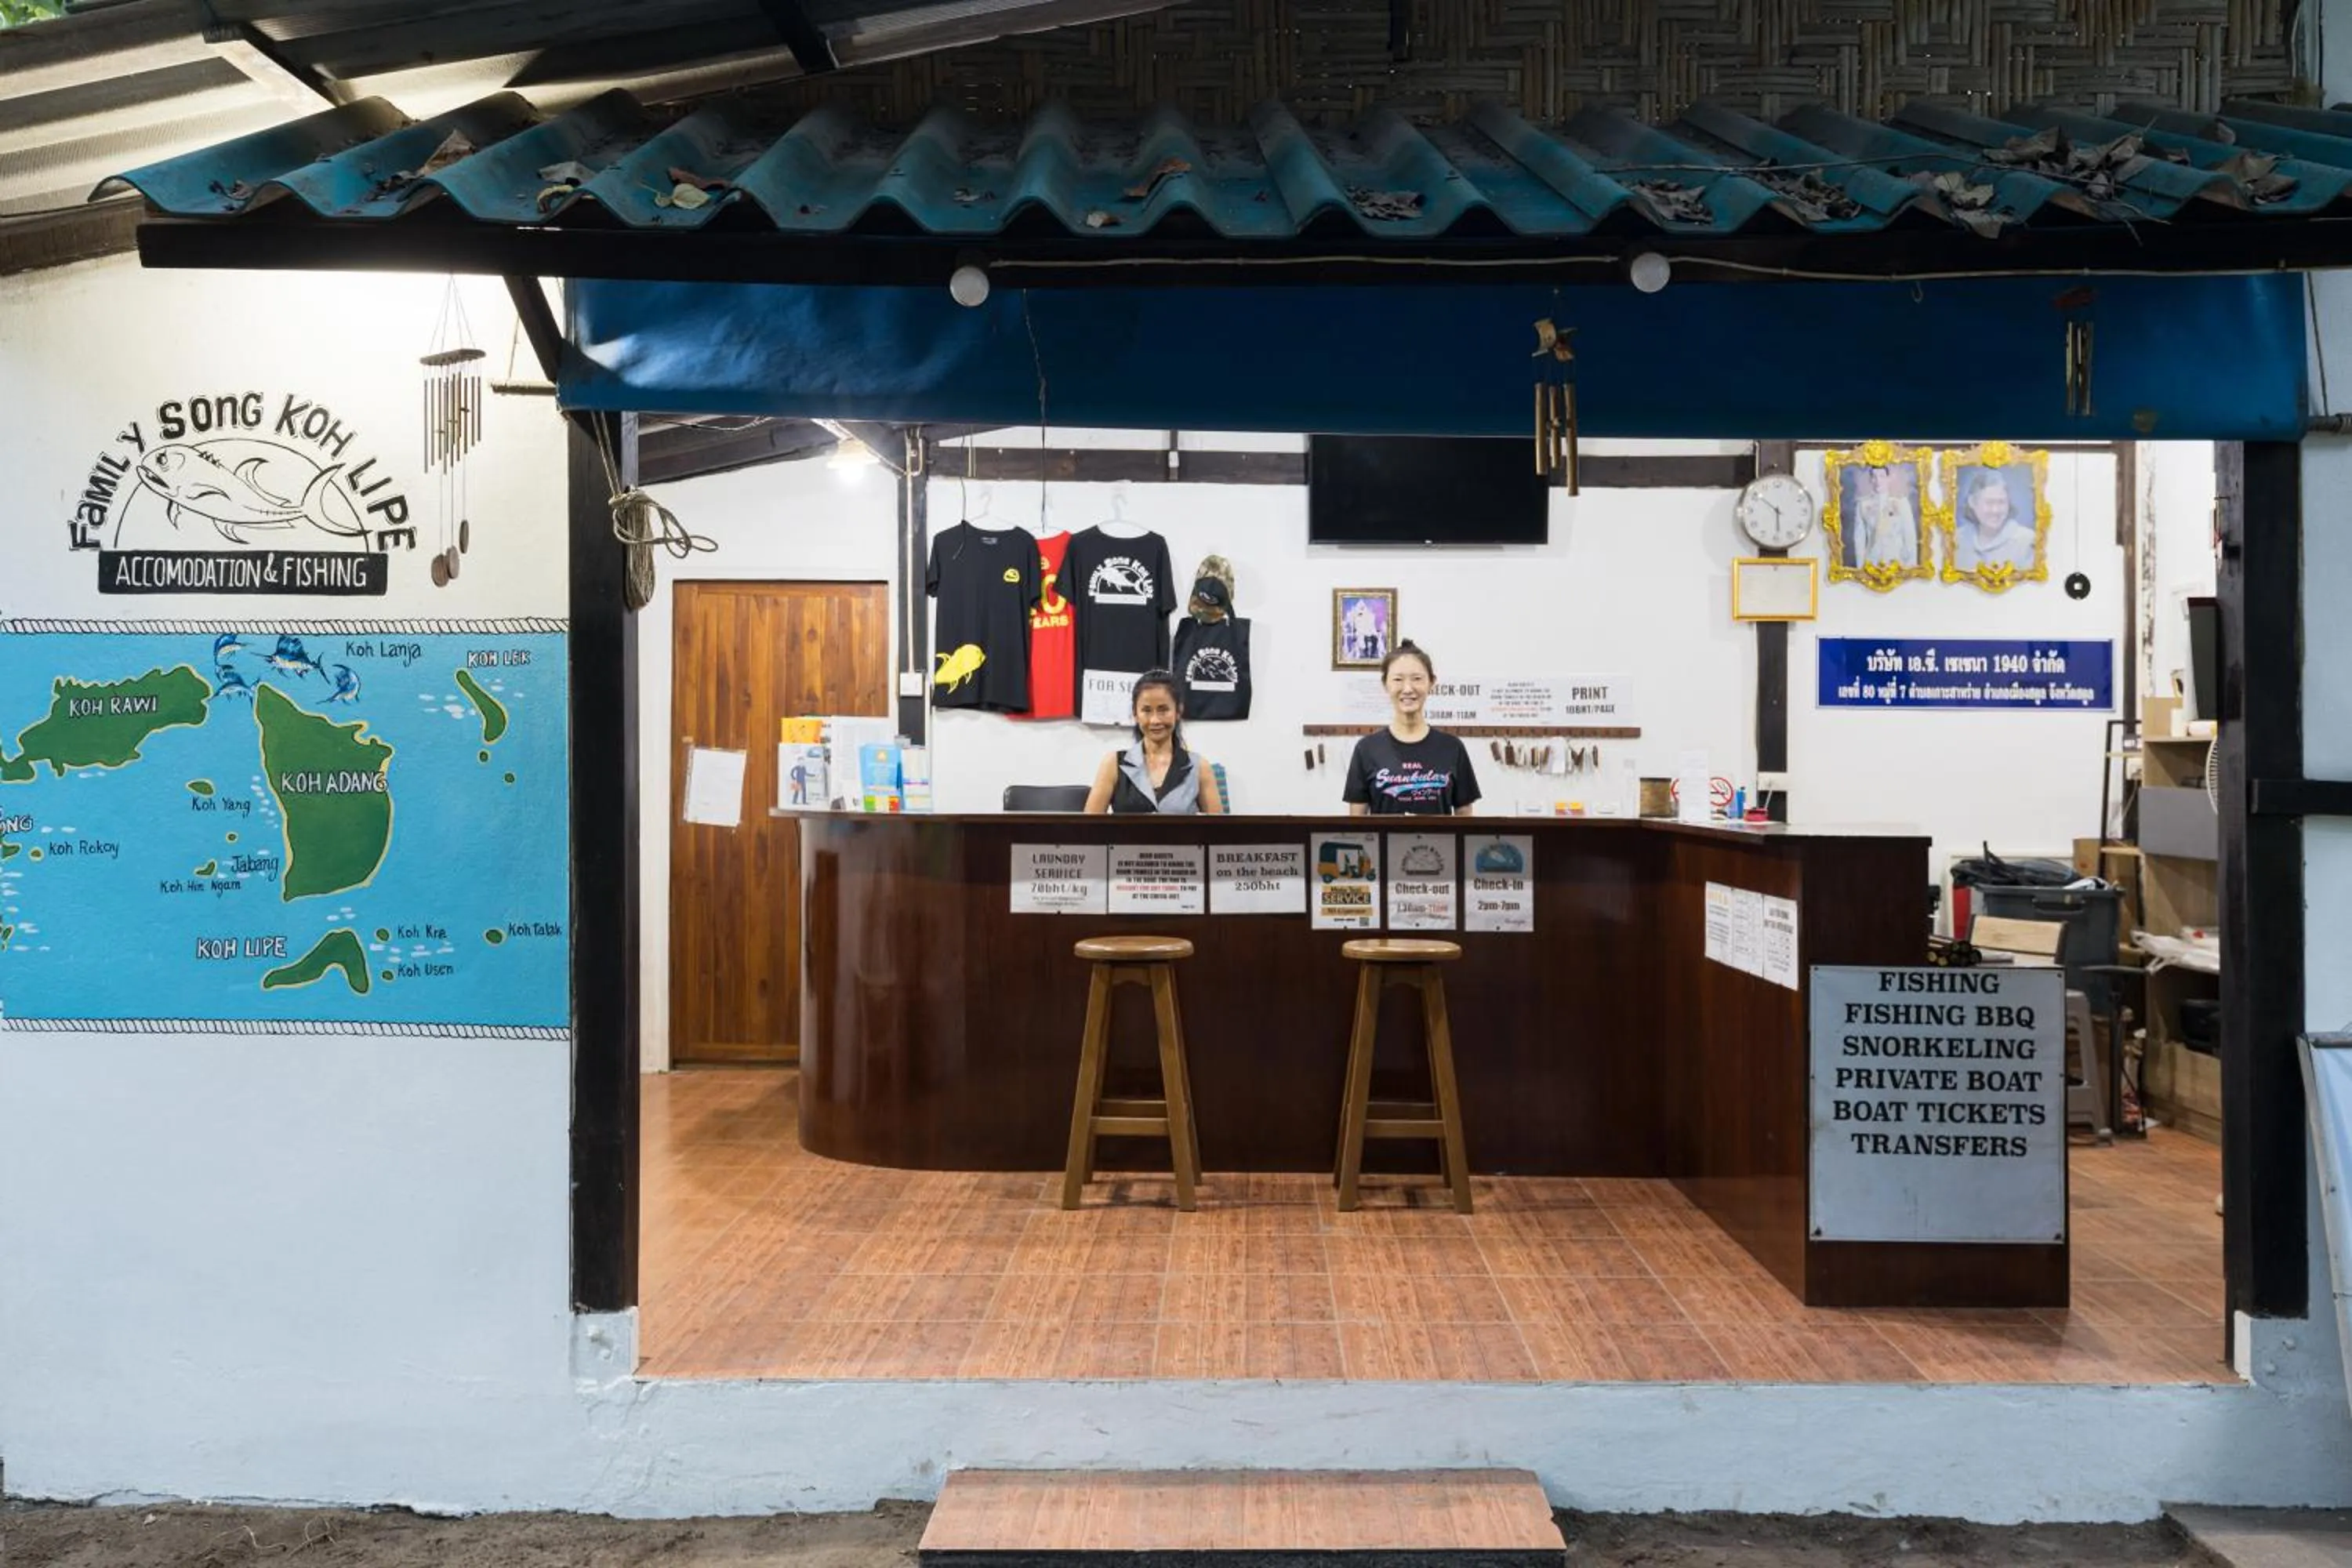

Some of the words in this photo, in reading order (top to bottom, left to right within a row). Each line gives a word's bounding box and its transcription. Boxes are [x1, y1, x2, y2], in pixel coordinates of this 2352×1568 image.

[274, 394, 356, 457] KOH
[345, 457, 417, 551] LIPE
[115, 557, 261, 587] ACCOMODATION
[282, 557, 367, 587] FISHING
[1029, 615, 1069, 629] EARS
[346, 641, 375, 657] Koh
[380, 641, 422, 666] Lanja
[467, 652, 499, 666] KOH
[503, 651, 530, 665] LEK
[1993, 654, 2028, 673] 1940
[2032, 649, 2066, 673] จำกัด
[1572, 686, 1609, 700] PRINT
[1900, 684, 1906, 699] 7
[69, 698, 103, 718] KOH
[110, 695, 157, 715] RAWI
[281, 772, 321, 793] KOH
[325, 771, 387, 794] ADANG
[191, 797, 216, 811] Koh
[222, 797, 251, 818] Yang
[49, 842, 74, 855] Koh
[1217, 852, 1298, 863] BREAKFAST
[1033, 853, 1086, 864] LAUNDRY
[1035, 868, 1083, 879] SERVICE
[1216, 868, 1232, 877] on
[1236, 866, 1257, 877] the
[1260, 866, 1298, 876] beach
[160, 880, 183, 893] Koh
[1396, 883, 1450, 895] Check-out
[397, 924, 419, 938] Koh
[508, 923, 531, 937] Koh
[197, 938, 238, 959] KOH
[244, 936, 287, 958] LIPE
[397, 964, 420, 978] Koh
[1878, 971, 2000, 994] FISHING
[1845, 1003, 1966, 1026] FISHING
[1976, 1006, 2036, 1029] BBQ
[1842, 1036, 2037, 1059] SNORKELING
[1835, 1068, 1958, 1091] PRIVATE
[1966, 1071, 2042, 1092] BOAT
[1832, 1100, 1908, 1121] BOAT
[1917, 1102, 2046, 1124] TICKETS
[1851, 1134, 2028, 1157] TRANSFERS
